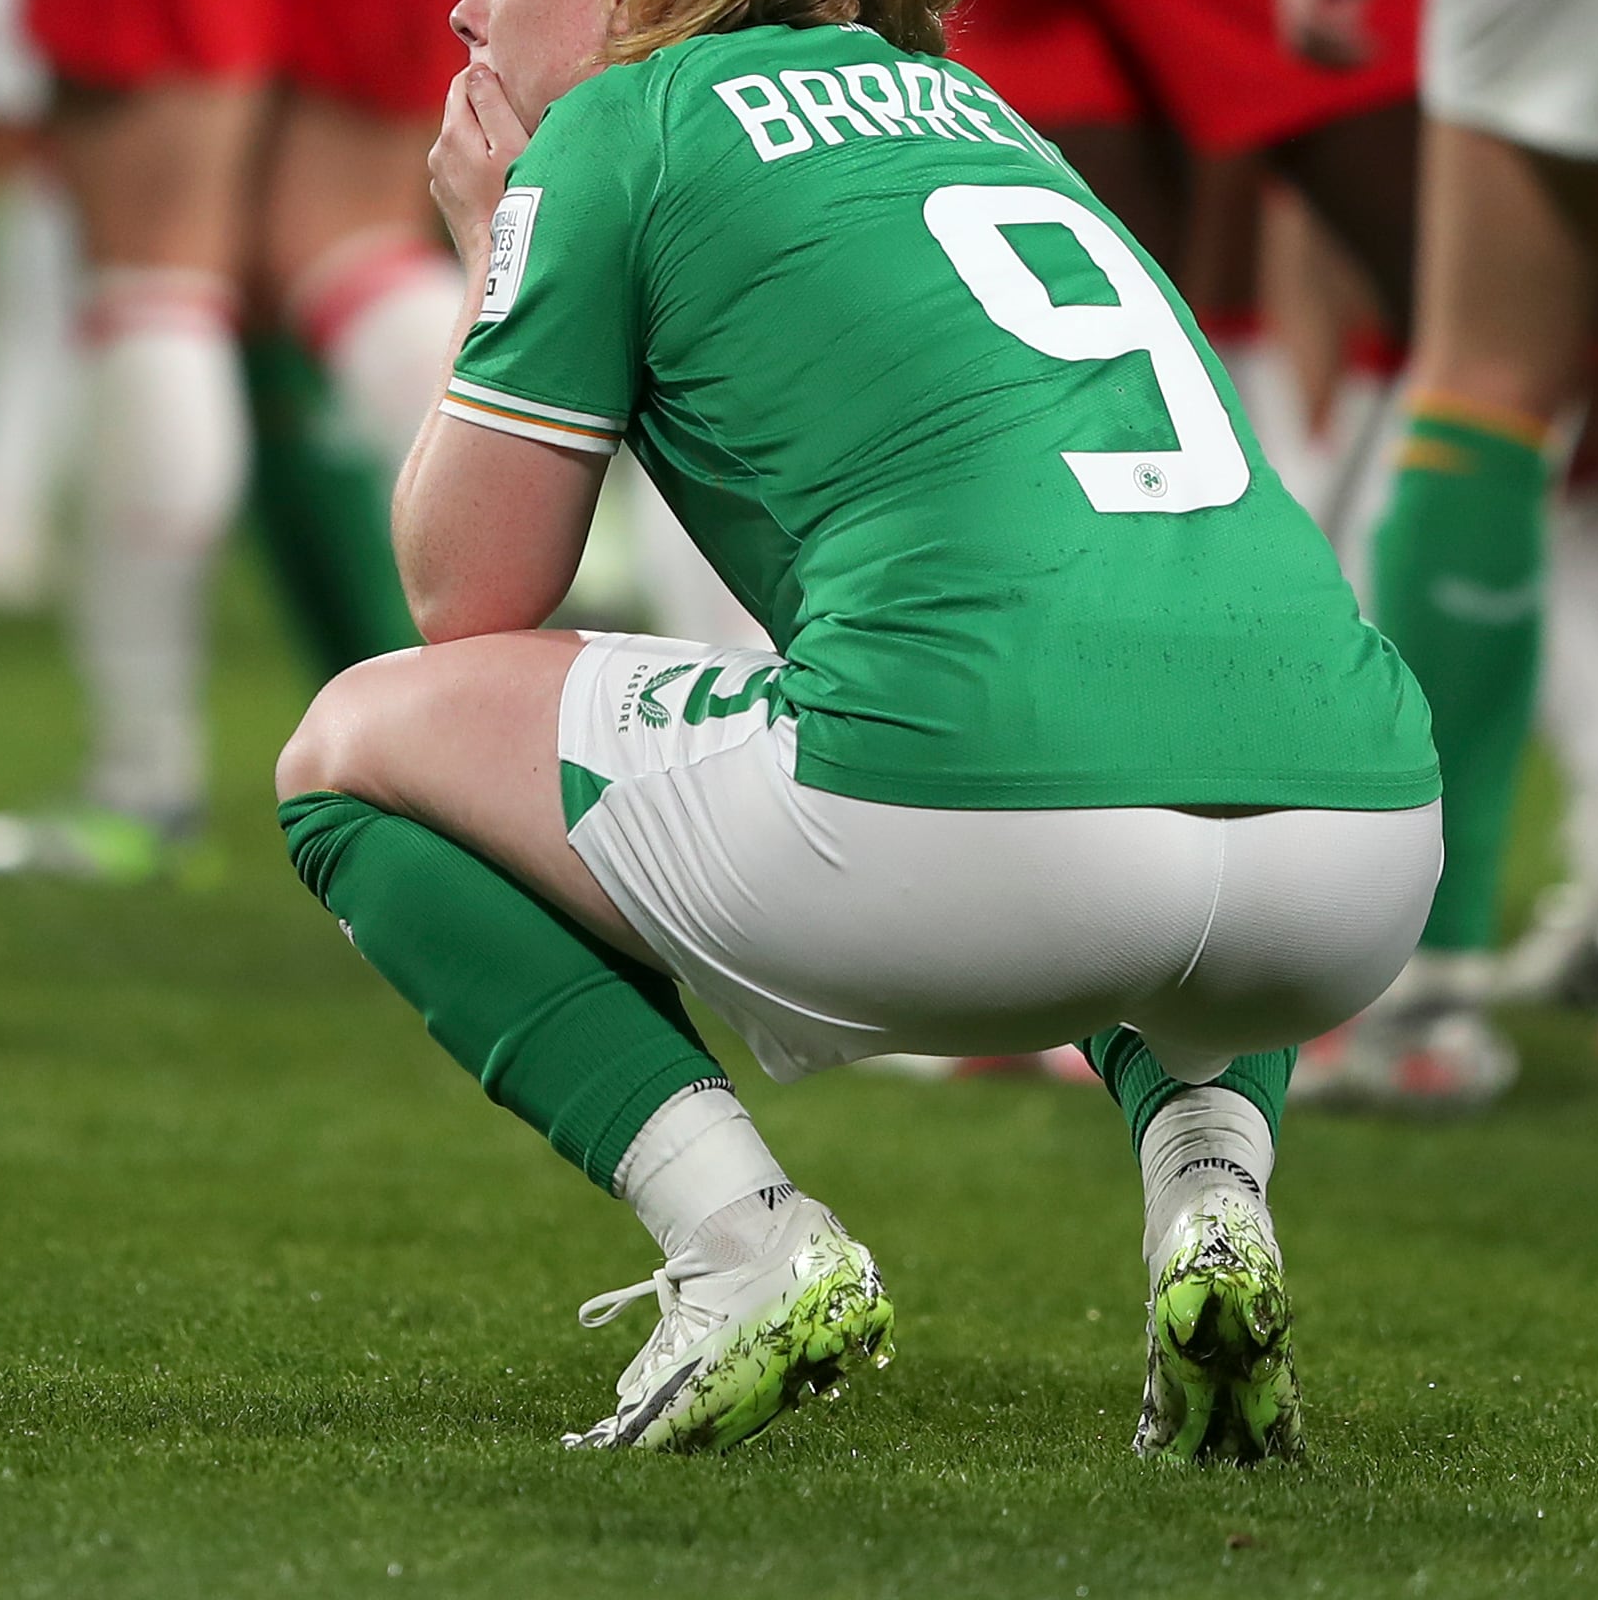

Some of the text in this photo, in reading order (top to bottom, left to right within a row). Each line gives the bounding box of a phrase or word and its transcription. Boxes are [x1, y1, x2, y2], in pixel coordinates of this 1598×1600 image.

[711, 60, 1087, 191] BARRET
[923, 184, 1251, 514] 9
[617, 663, 649, 734] CASTORE
